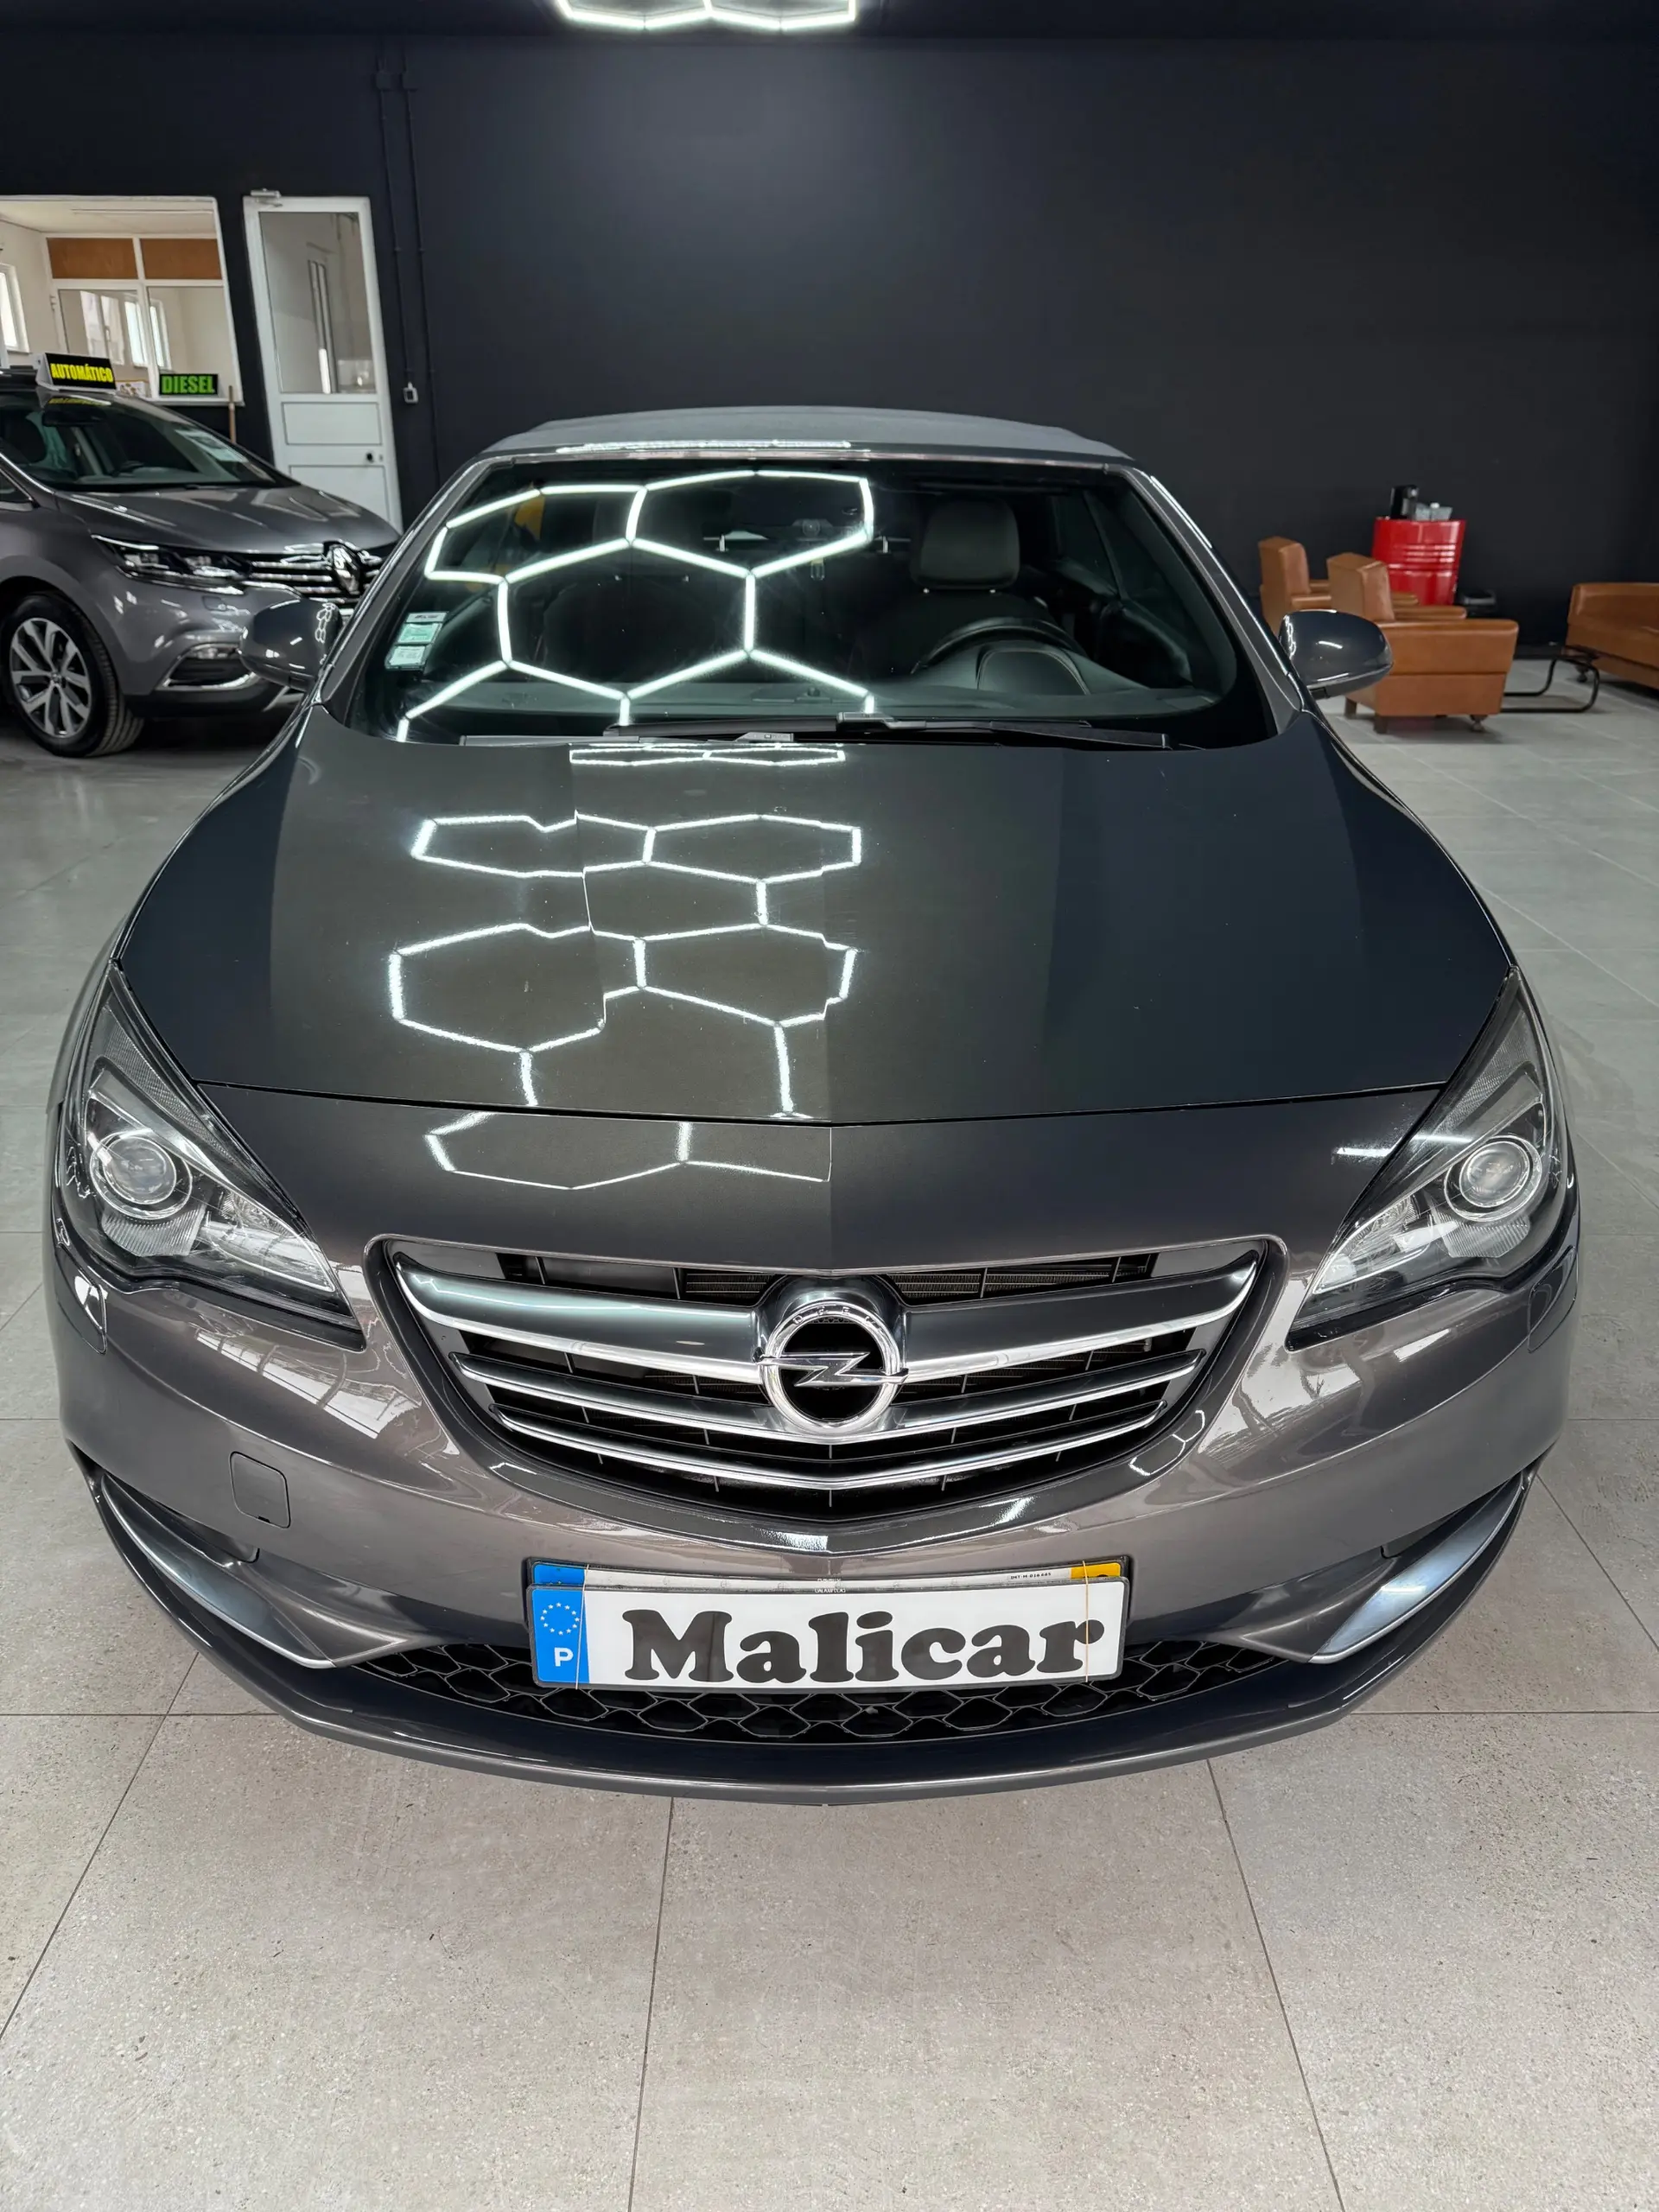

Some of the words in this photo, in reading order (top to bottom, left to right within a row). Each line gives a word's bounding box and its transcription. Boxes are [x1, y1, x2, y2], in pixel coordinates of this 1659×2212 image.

[50, 363, 114, 383] AUTOMÁTICO
[162, 375, 215, 393] DIESEL
[622, 1609, 1105, 1684] Malicar
[554, 1647, 574, 1667] P
